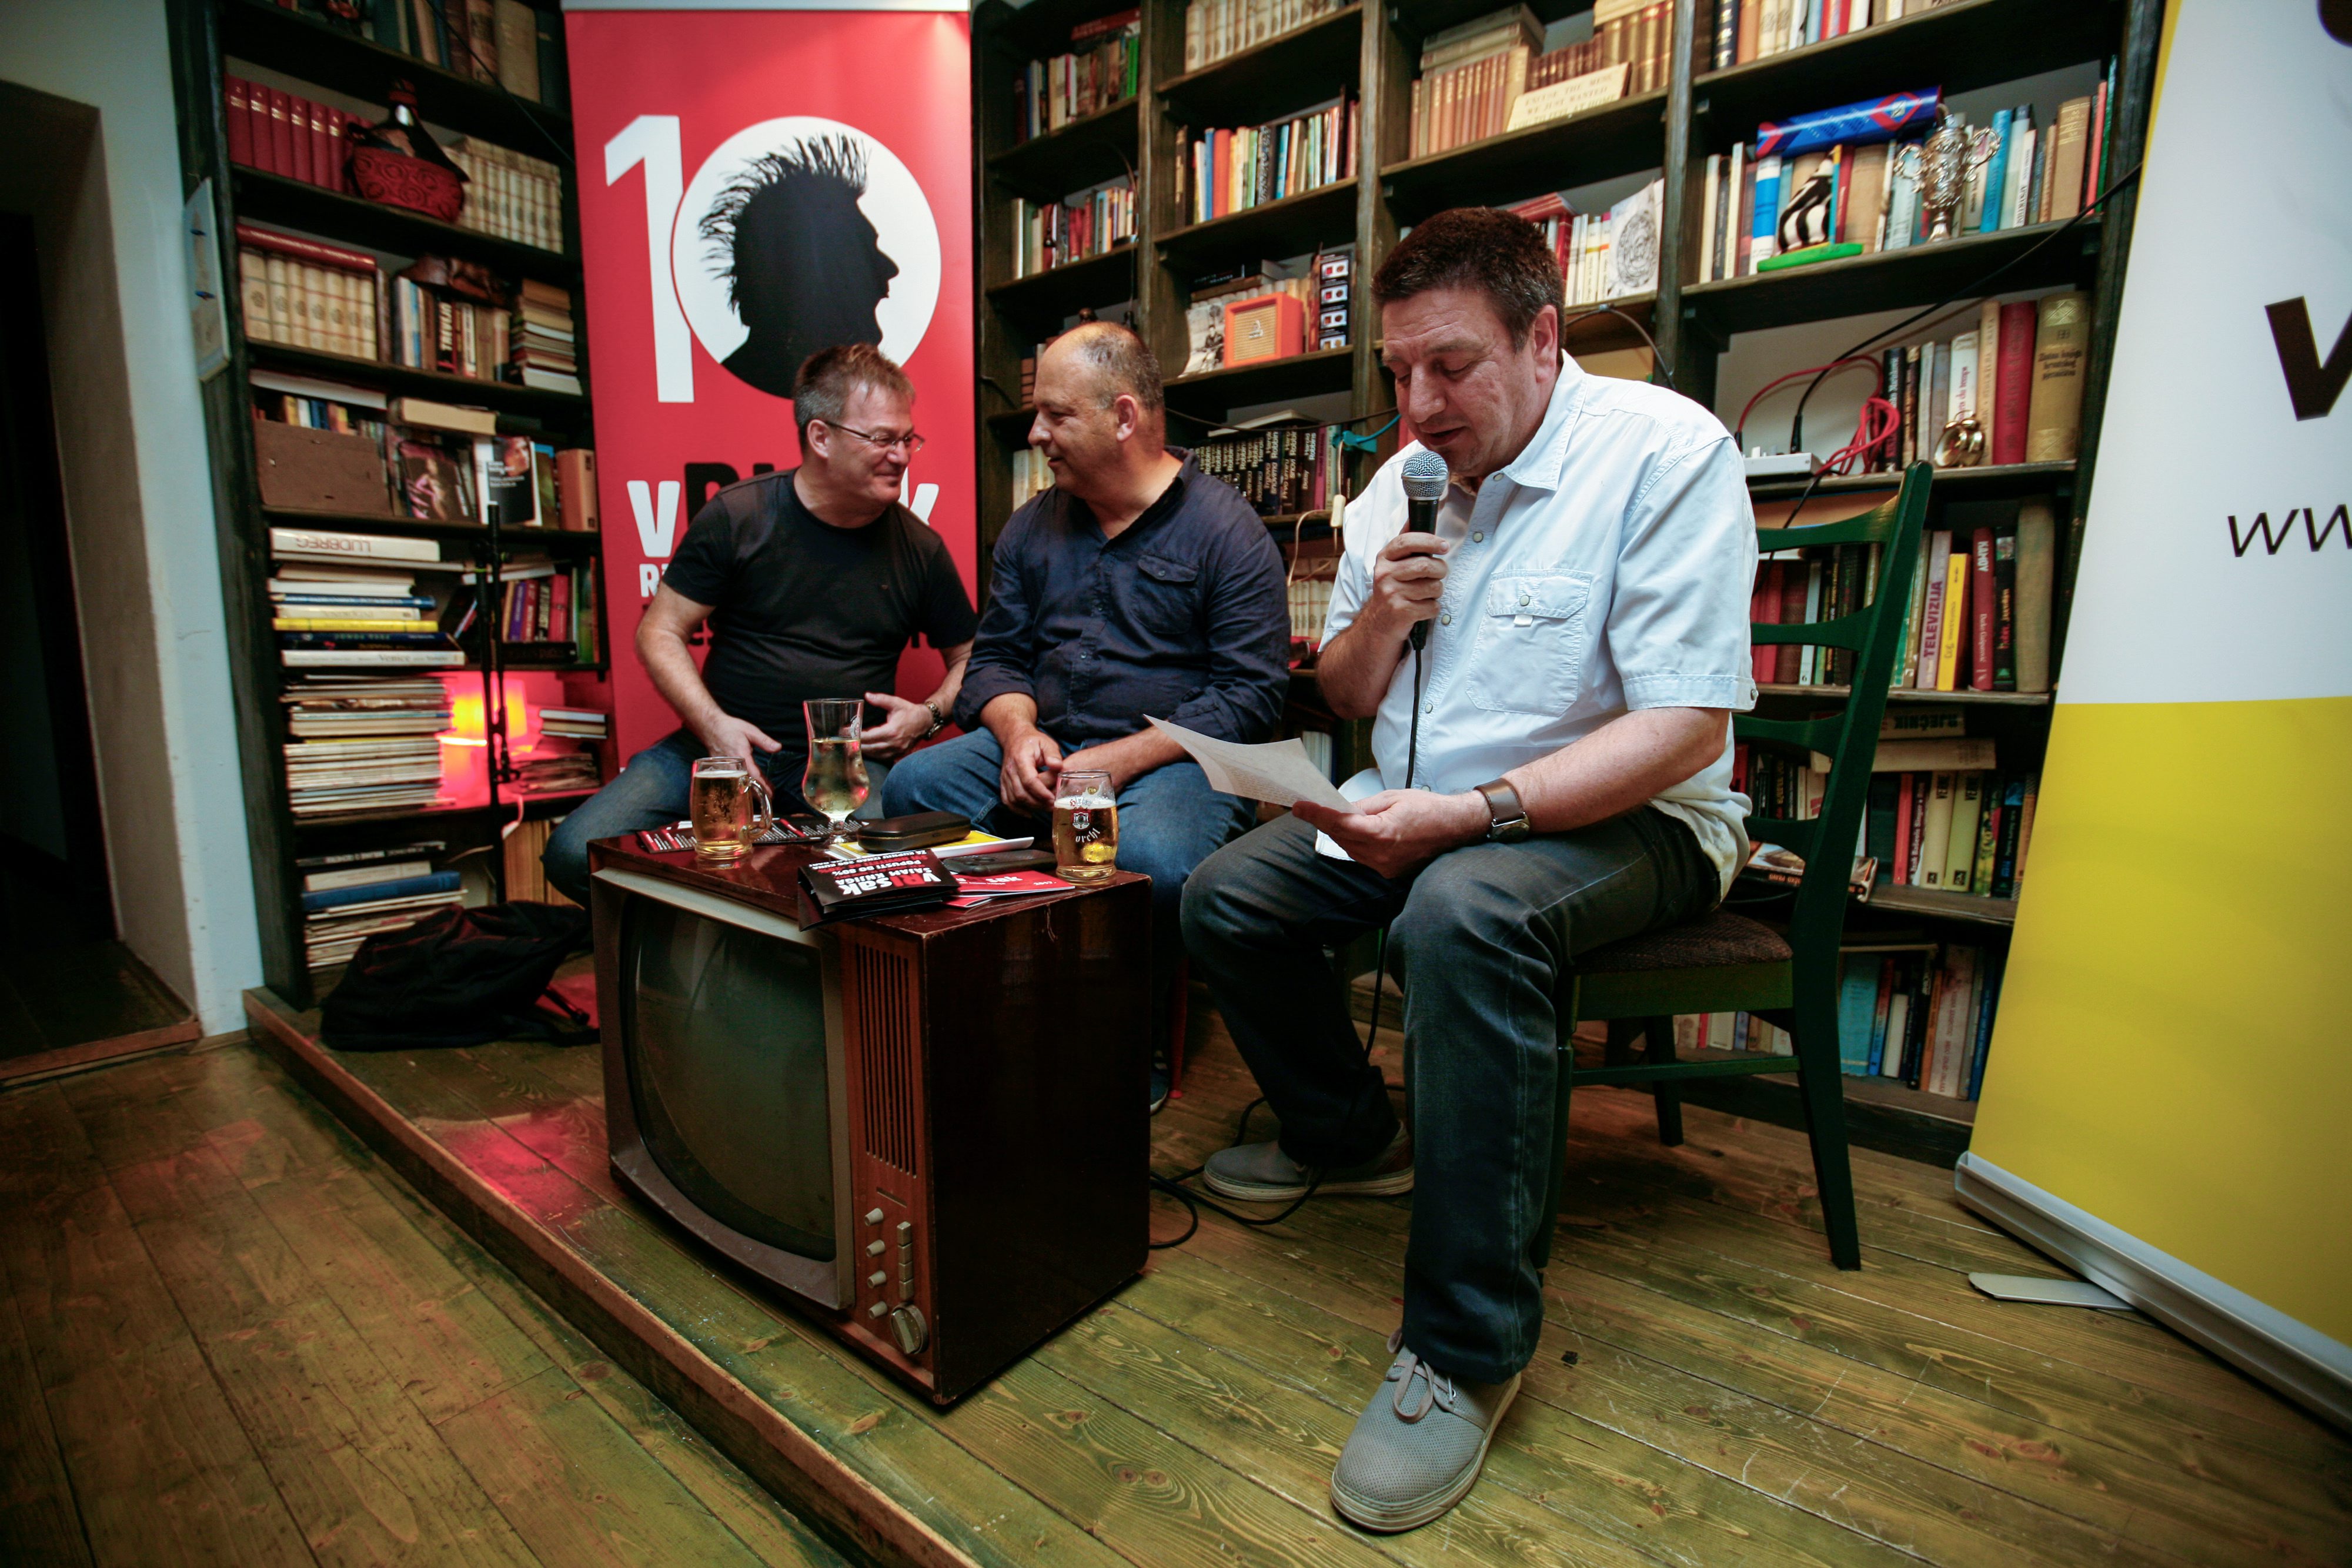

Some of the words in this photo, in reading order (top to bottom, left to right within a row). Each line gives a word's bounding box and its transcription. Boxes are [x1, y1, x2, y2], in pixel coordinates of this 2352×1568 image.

[1976, 540, 1989, 573] KAMOV
[1923, 580, 1943, 657] TELEVIZIJA
[1894, 713, 1958, 731] RJEČNIK
[876, 860, 921, 870] POPUSTI
[831, 868, 857, 877] 80%
[888, 867, 933, 877] SAJAM
[834, 873, 886, 885] KNJIGA
